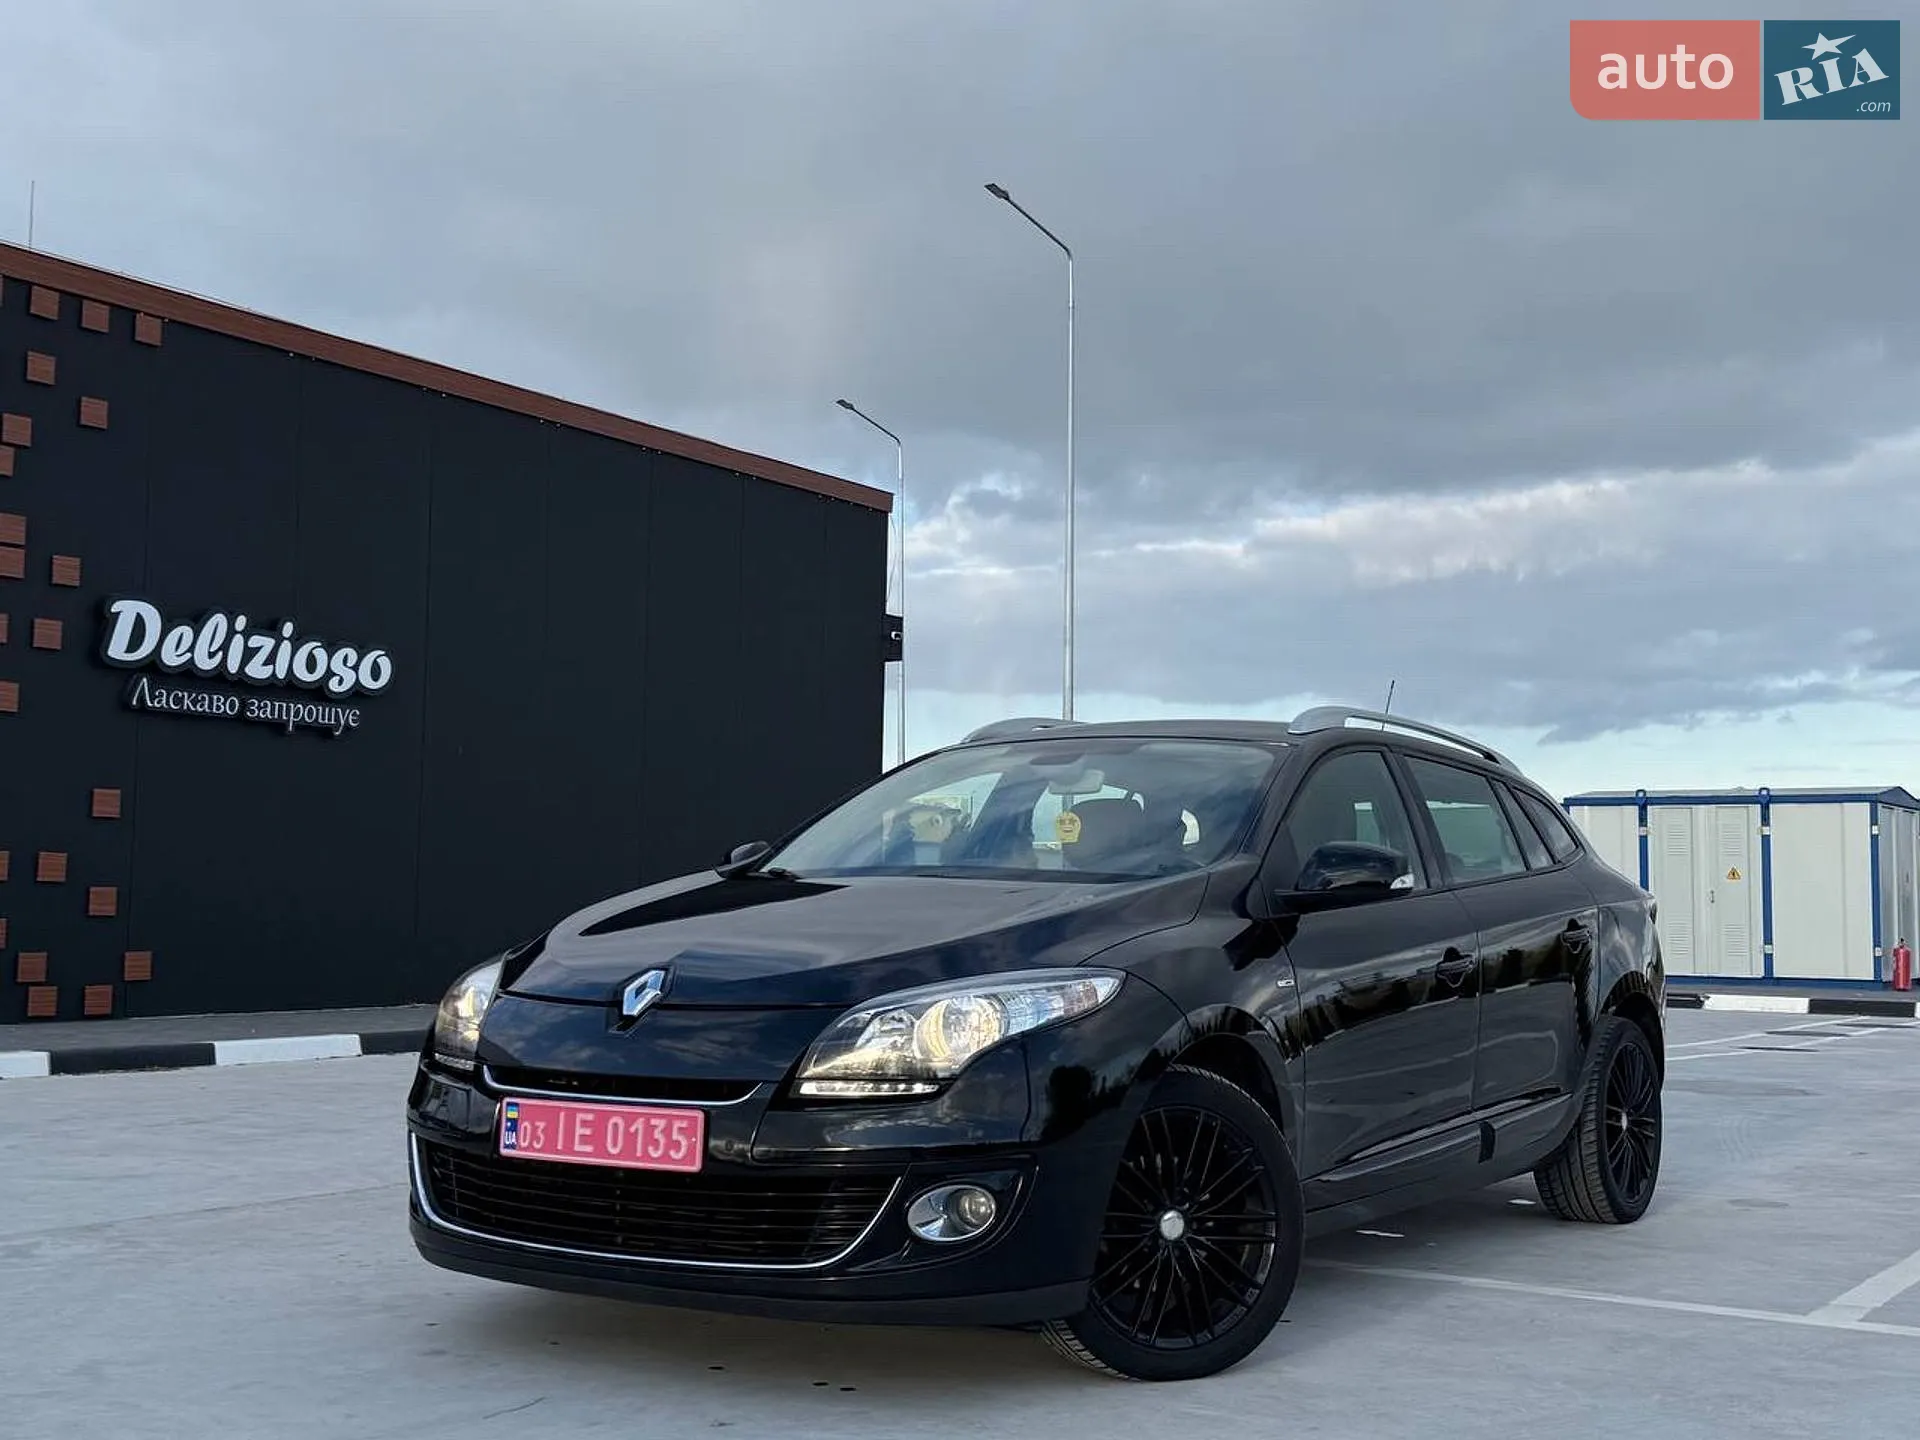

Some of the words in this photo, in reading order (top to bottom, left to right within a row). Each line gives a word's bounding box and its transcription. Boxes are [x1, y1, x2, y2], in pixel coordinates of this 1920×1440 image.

[106, 599, 393, 693] Delizioso
[131, 676, 240, 716] Ласкаво
[246, 697, 361, 736] запрошує
[504, 1130, 517, 1145] UA
[520, 1121, 546, 1149] 03
[605, 1116, 689, 1160] 0135
